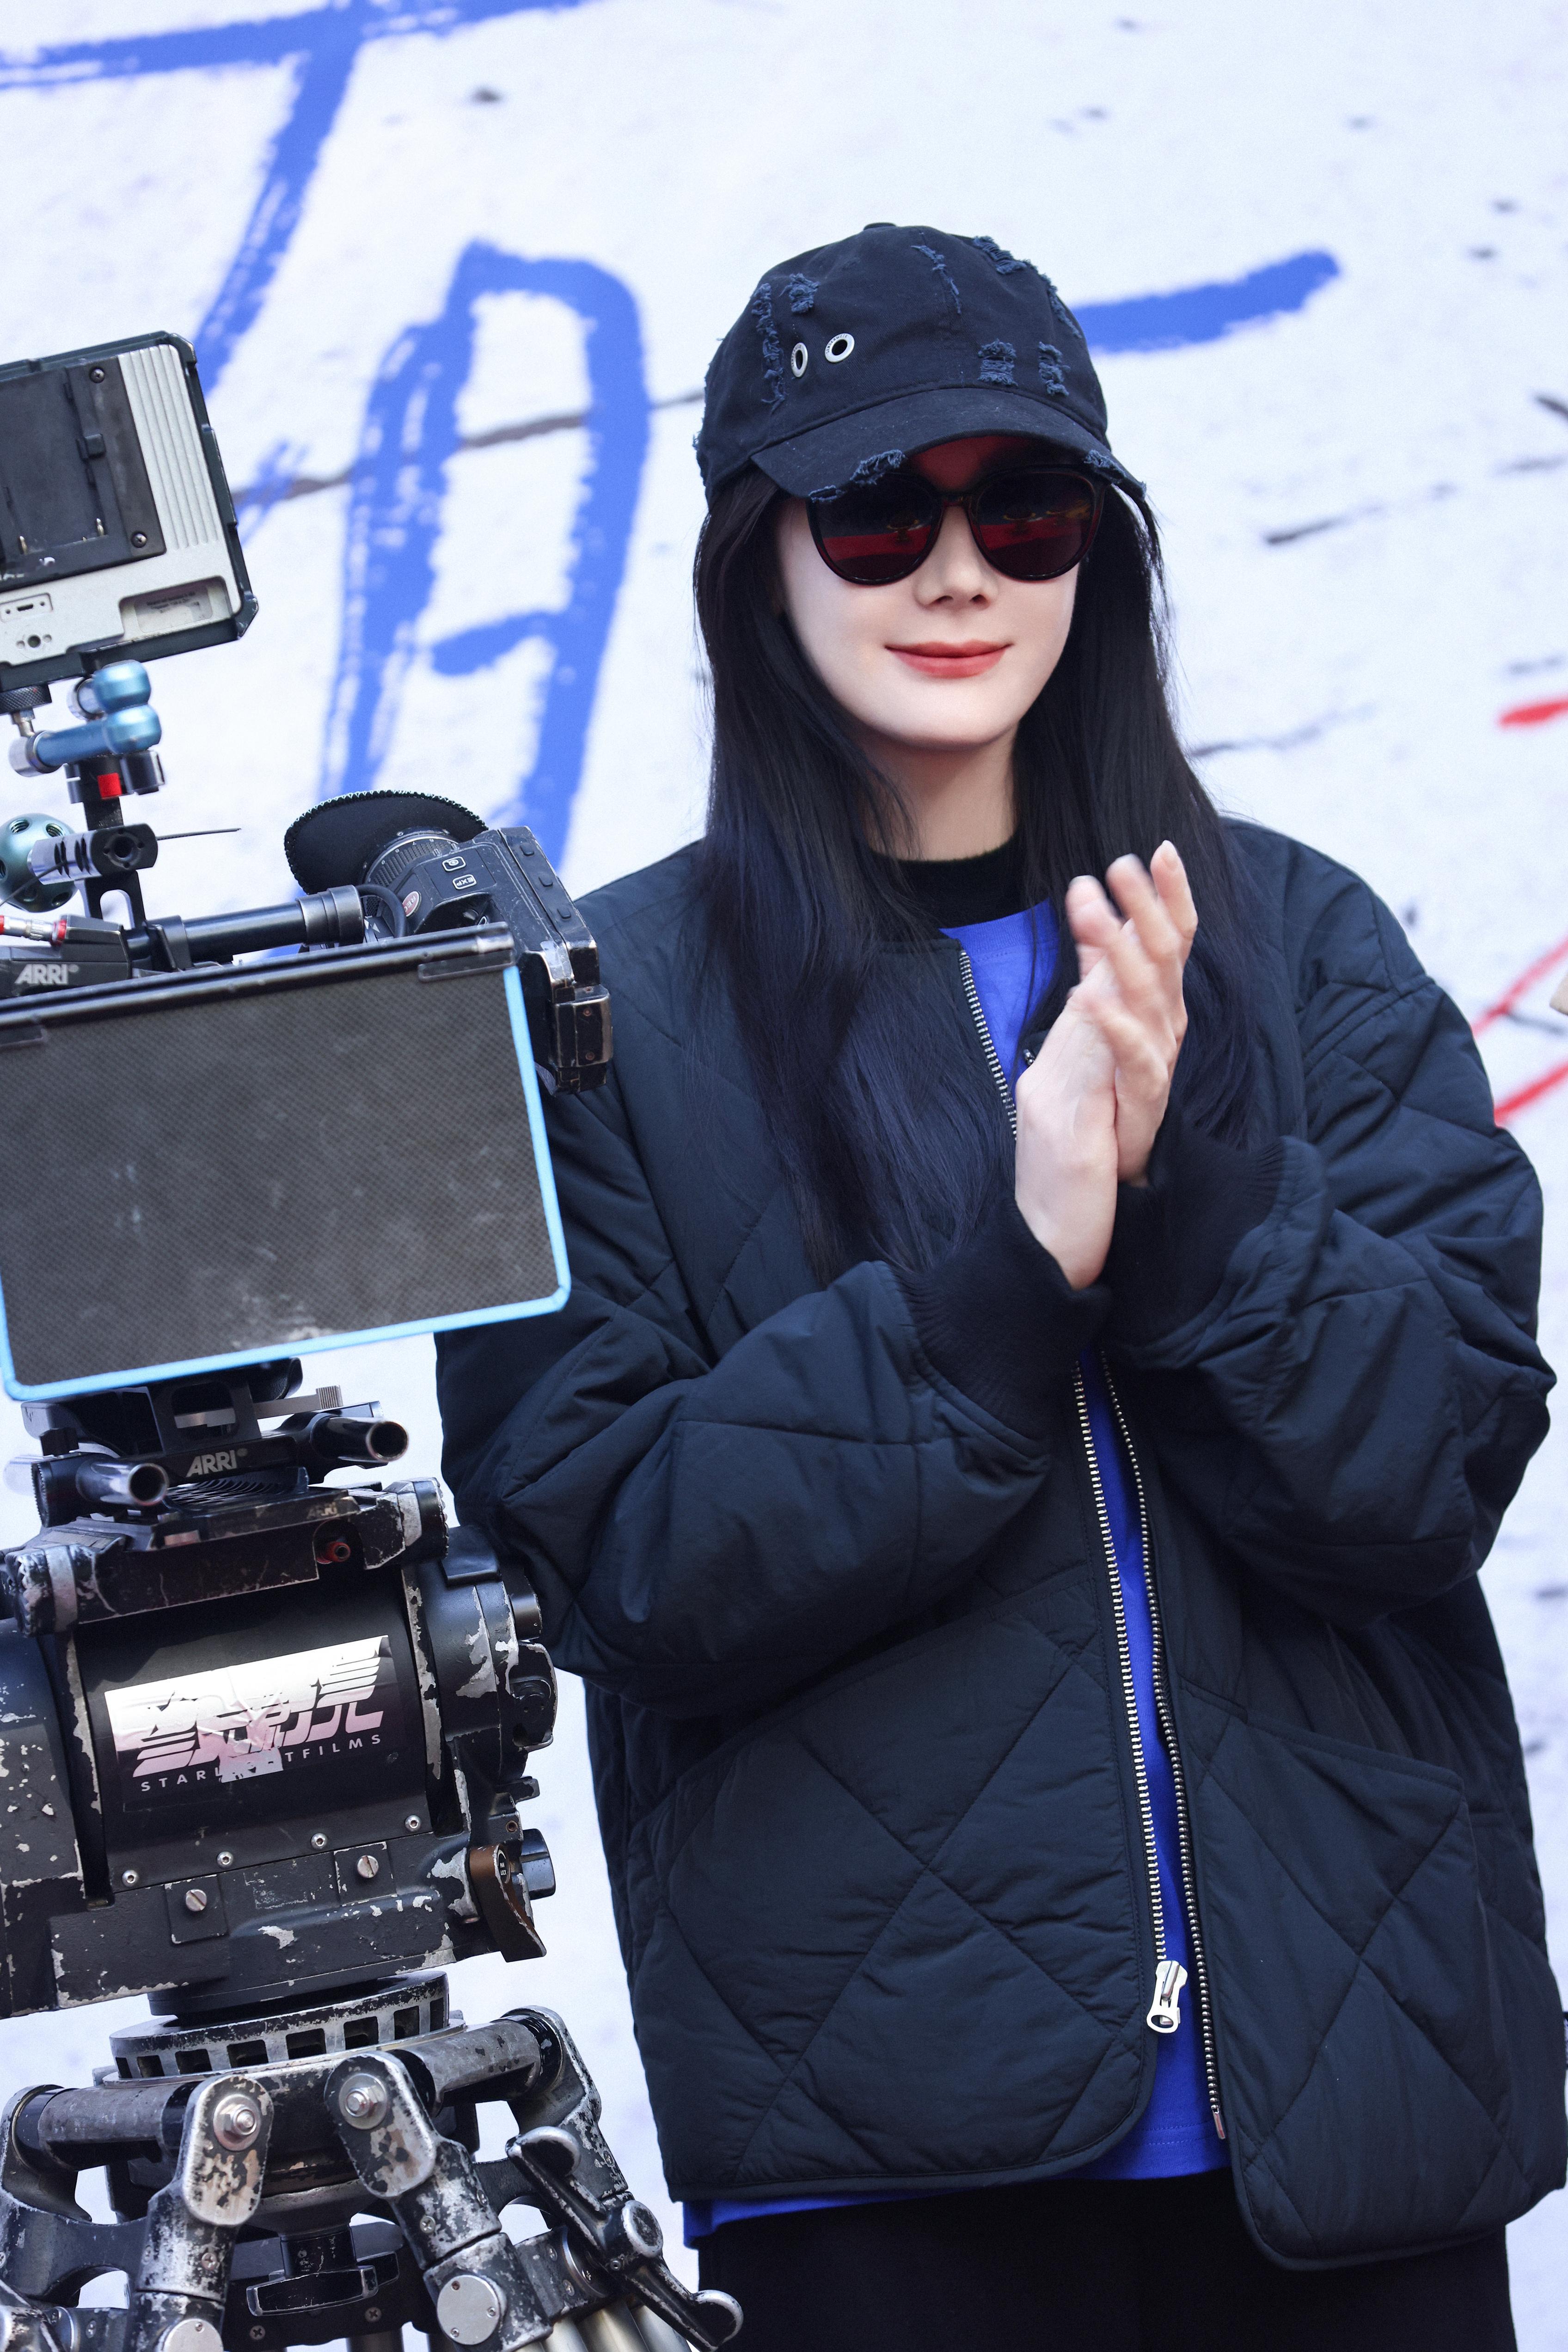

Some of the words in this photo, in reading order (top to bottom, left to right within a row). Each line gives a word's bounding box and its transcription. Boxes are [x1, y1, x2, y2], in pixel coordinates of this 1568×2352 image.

[456, 877, 474, 886] EXP
[14, 964, 68, 984] ARRI
[186, 1450, 237, 1477] ARRI
